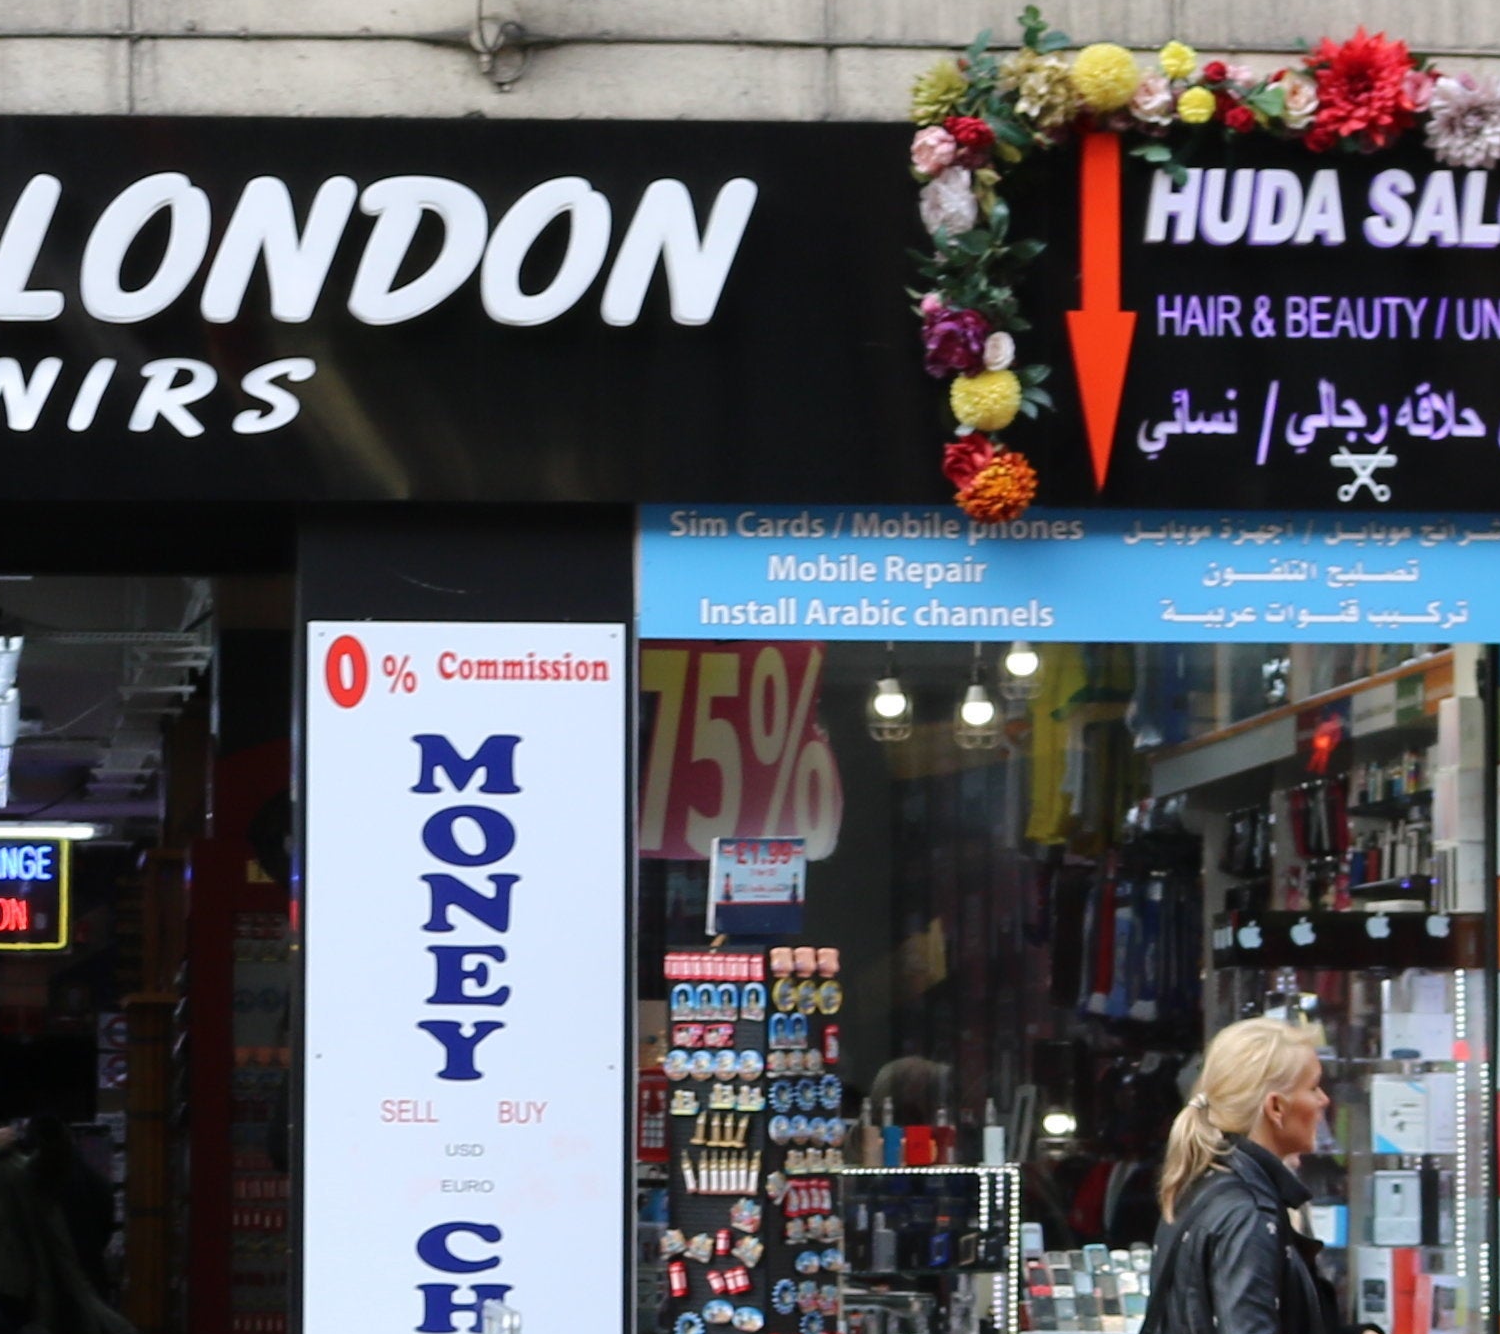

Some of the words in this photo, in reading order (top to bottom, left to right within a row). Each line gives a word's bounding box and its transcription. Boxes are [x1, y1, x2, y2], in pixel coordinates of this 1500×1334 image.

[1143, 168, 1346, 249] HUDA
[1157, 296, 1242, 337] HAIR
[1252, 296, 1277, 338] &
[1285, 296, 1427, 339] BEAUTY
[1136, 387, 1239, 461] نسائي
[1285, 378, 1388, 456] رجالي
[669, 511, 728, 537] Sim
[736, 511, 825, 539] Cards
[852, 511, 960, 540] Mobile
[967, 516, 1085, 546] phones
[767, 554, 877, 583] Mobile
[885, 556, 988, 589] Repair
[701, 597, 798, 626] Install
[804, 598, 908, 627] Arabic
[913, 599, 1055, 628] channels
[437, 650, 611, 683] Commission
[639, 645, 839, 862] 75%
[409, 732, 524, 1082] MONEY
[380, 1099, 440, 1124] SELL
[497, 1100, 549, 1124] BUY
[444, 1142, 485, 1158] USD
[440, 1178, 495, 1195] EURO
